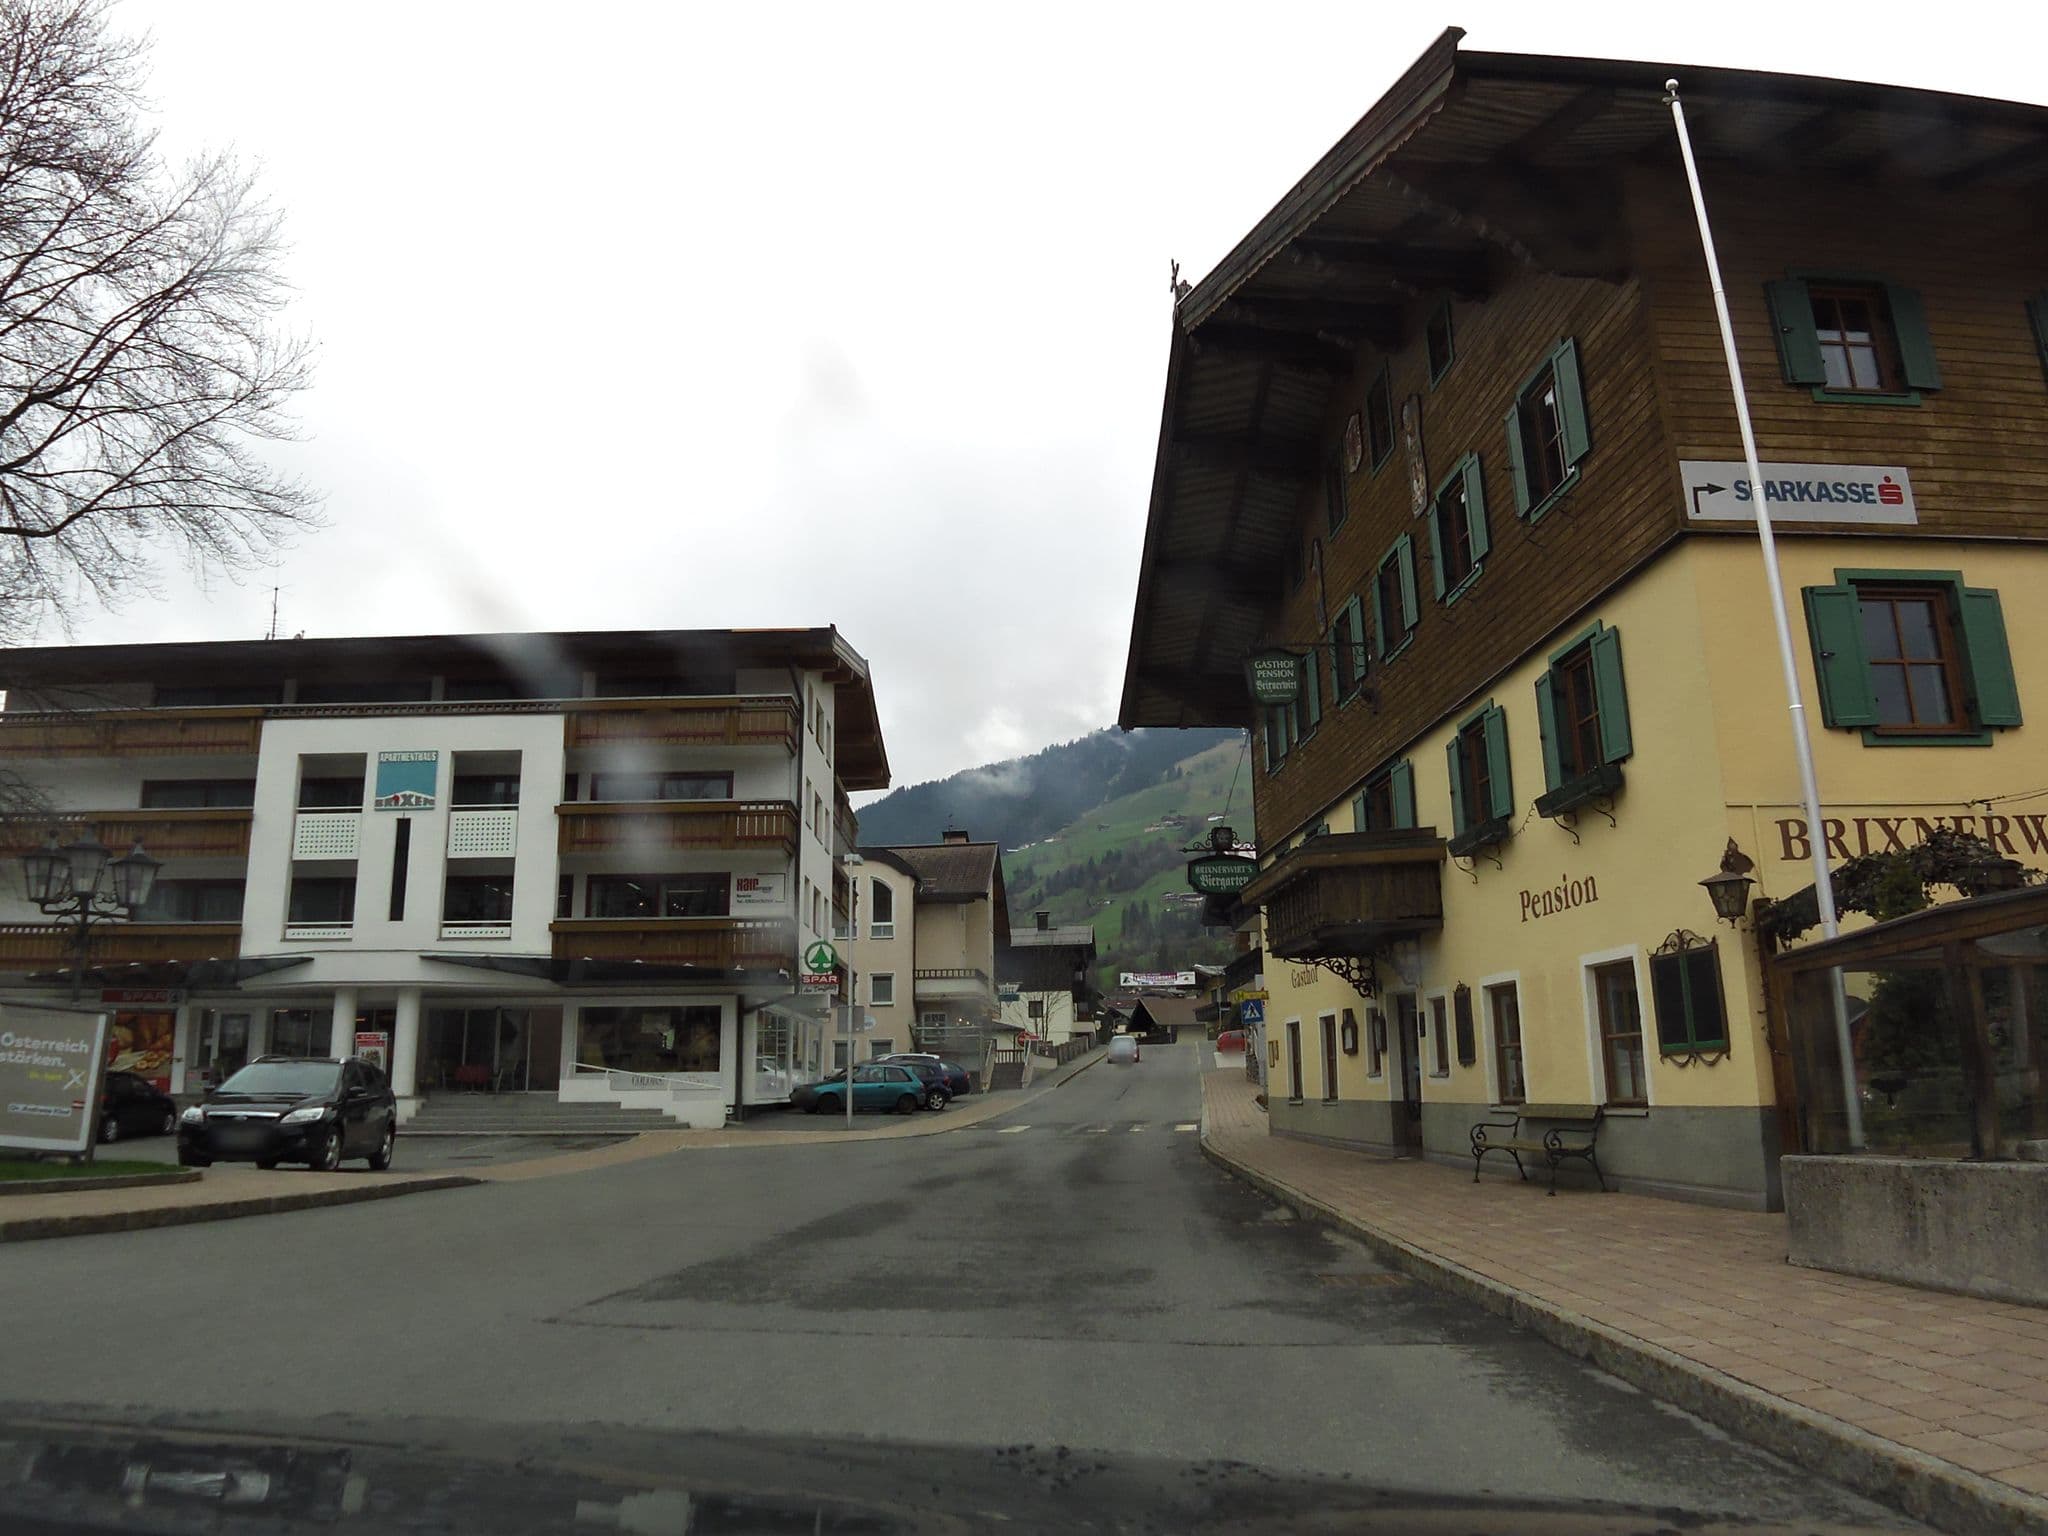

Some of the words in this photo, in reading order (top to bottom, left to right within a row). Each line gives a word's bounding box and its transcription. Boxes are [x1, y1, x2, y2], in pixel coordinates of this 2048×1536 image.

[1733, 479, 1877, 505] SARKASSE
[1254, 660, 1295, 669] GASTHOF
[1256, 669, 1294, 678] PENSION
[1199, 874, 1250, 890] Biergarten
[1519, 873, 1599, 923] Pension
[802, 975, 838, 984] SPAR
[1291, 965, 1319, 989] Gasthof
